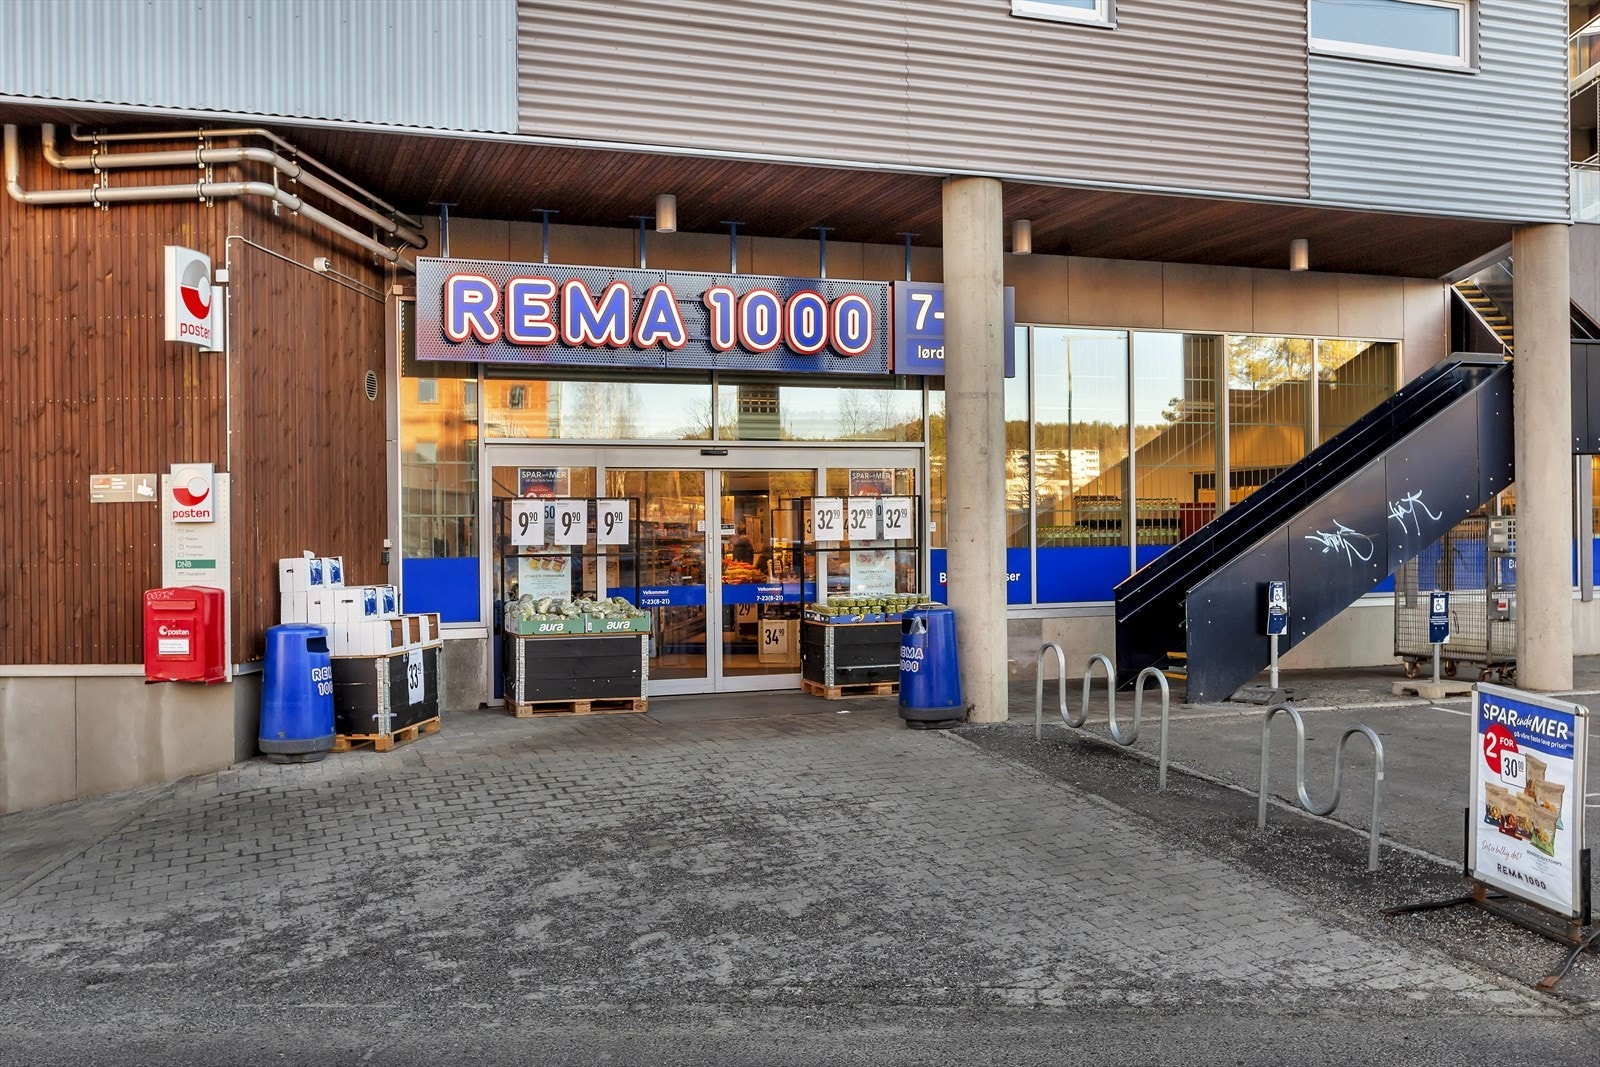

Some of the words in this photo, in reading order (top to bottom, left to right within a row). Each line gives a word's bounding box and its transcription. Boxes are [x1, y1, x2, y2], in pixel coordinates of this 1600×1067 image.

[444, 272, 688, 350] REMA
[703, 285, 875, 357] 1000
[172, 508, 210, 520] posten
[177, 560, 192, 569] DNB
[539, 623, 564, 632] aura
[606, 620, 630, 630] aura
[167, 628, 190, 636] posten
[900, 646, 924, 660] EMA
[900, 659, 919, 673] 000
[1483, 702, 1518, 727] SPAR
[1531, 715, 1569, 740] MER
[1486, 731, 1498, 759] 2
[1499, 736, 1514, 748] FOR
[1550, 741, 1567, 750] priser
[1497, 862, 1523, 880] REMA
[1524, 874, 1546, 890] 1000
